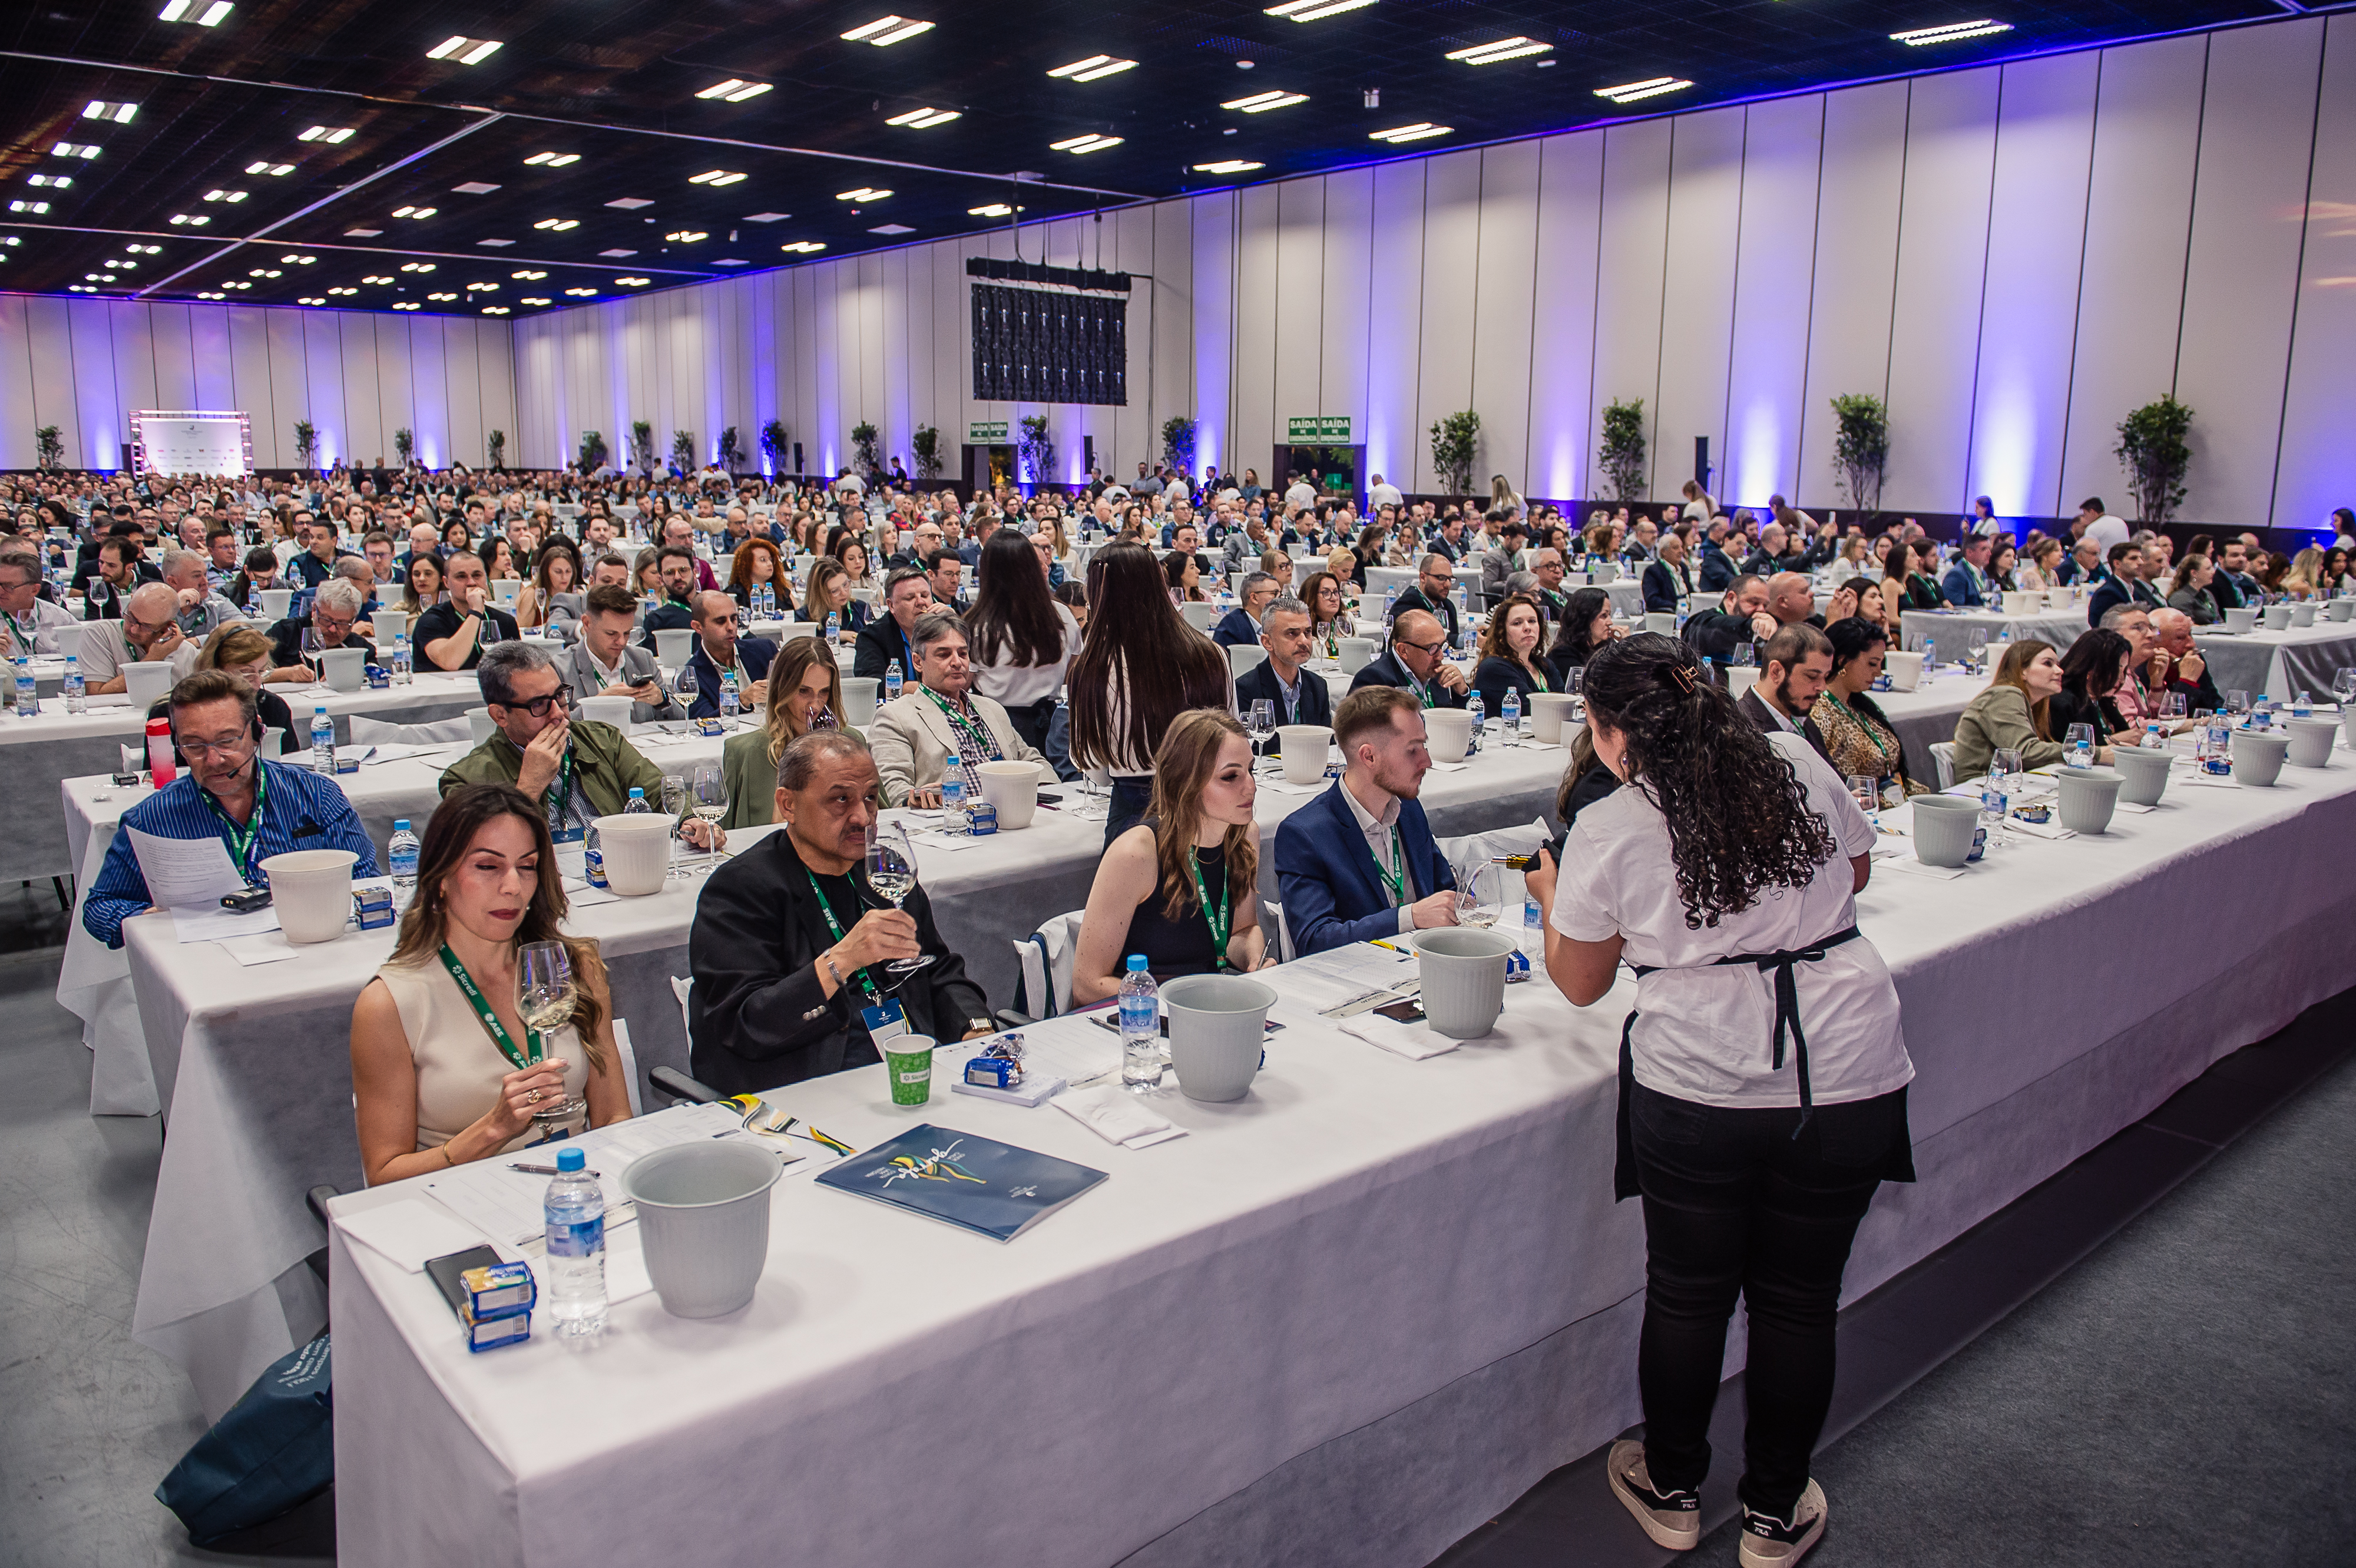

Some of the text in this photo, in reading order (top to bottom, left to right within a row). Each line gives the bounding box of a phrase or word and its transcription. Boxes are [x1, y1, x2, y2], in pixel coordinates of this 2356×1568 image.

[1290, 418, 1317, 429] SAÍDA
[1322, 418, 1349, 428] SAÍDA
[823, 907, 835, 922] ABE
[1211, 922, 1220, 941] Sicredi
[458, 973, 478, 996] Sicredi
[489, 1022, 504, 1038] ABE
[911, 1072, 928, 1080] Sicredi
[1755, 1527, 1769, 1536] FILA
